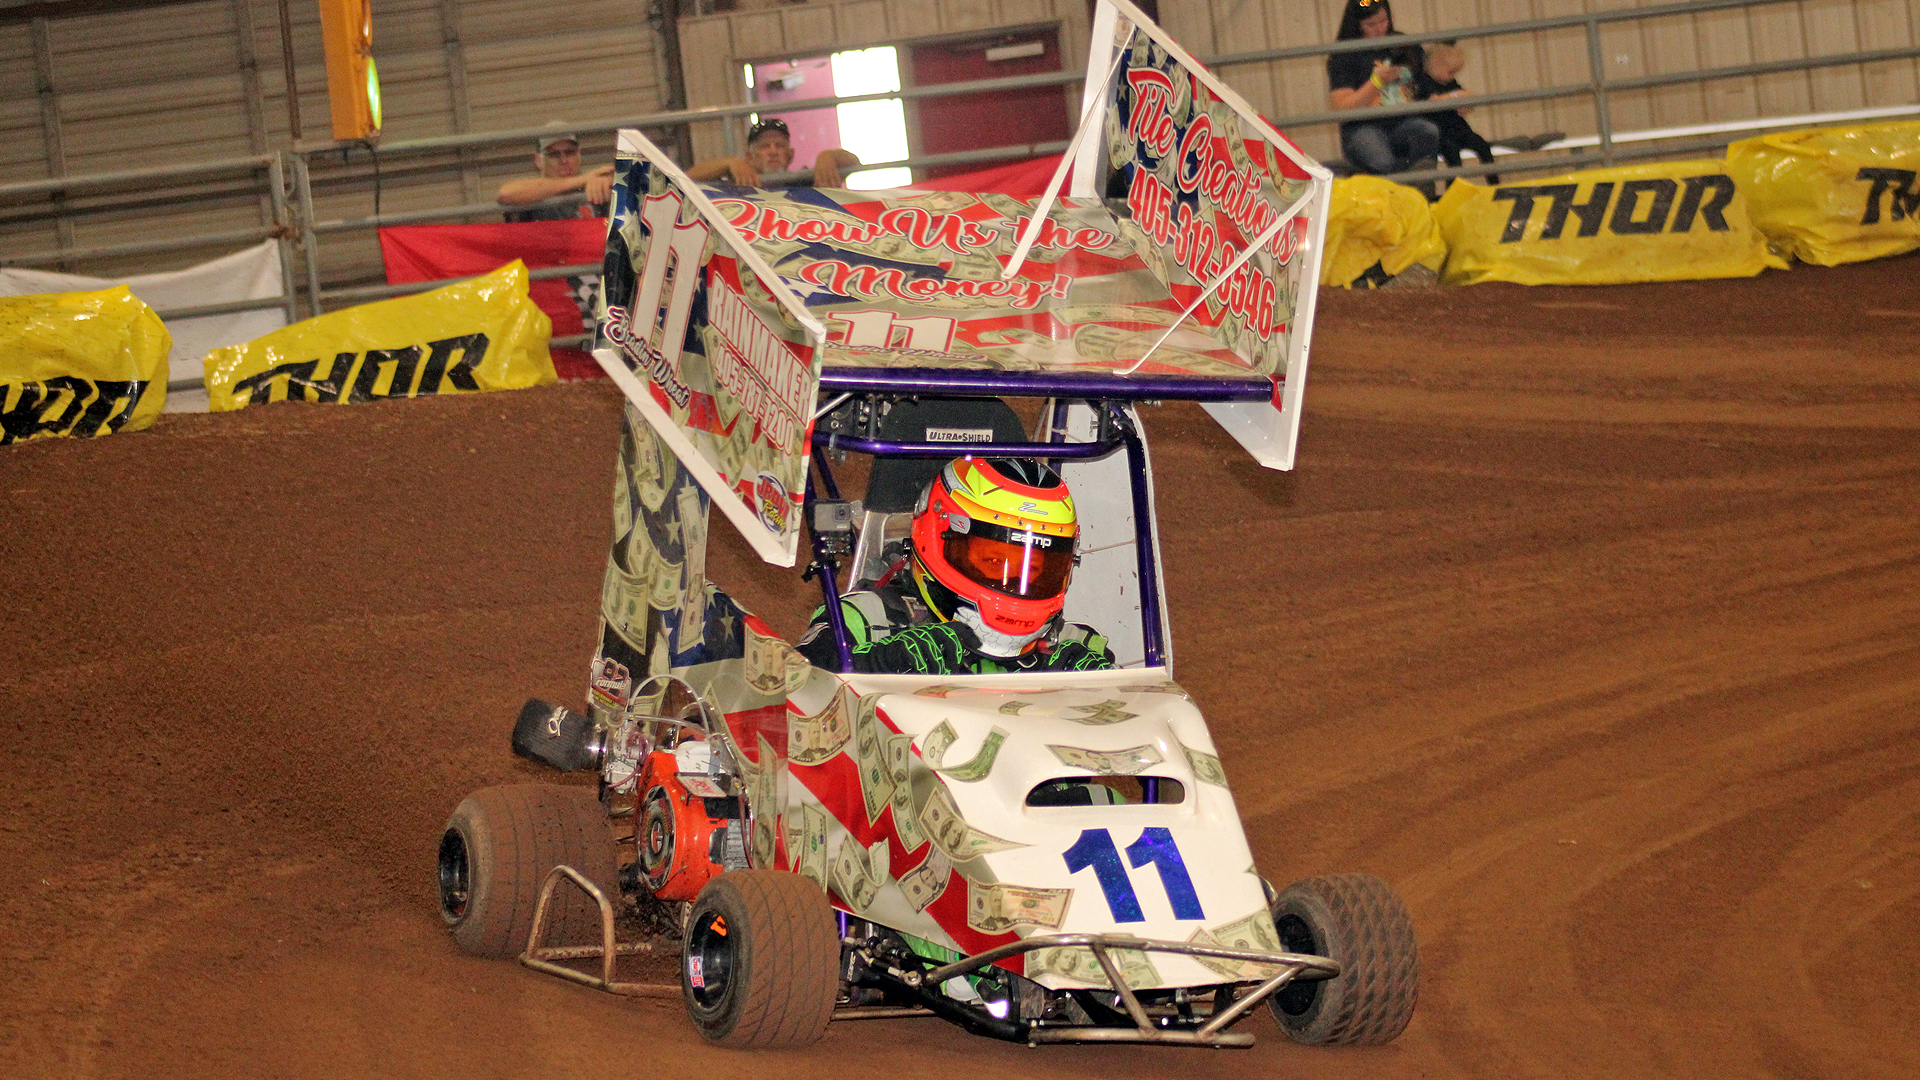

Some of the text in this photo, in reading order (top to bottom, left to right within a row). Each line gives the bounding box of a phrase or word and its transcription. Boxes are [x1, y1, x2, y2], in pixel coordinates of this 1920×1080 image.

[1126, 67, 1298, 267] Tile Creations
[710, 197, 1115, 256] Show Us the
[1490, 174, 1737, 245] THOR
[631, 190, 710, 377] 11
[798, 260, 1074, 310] Money!
[1127, 162, 1276, 343] 405-312-8546
[232, 333, 490, 402] THOR
[708, 271, 812, 429] RAINMAKER
[826, 309, 958, 354] 11
[1061, 827, 1206, 923] 11
